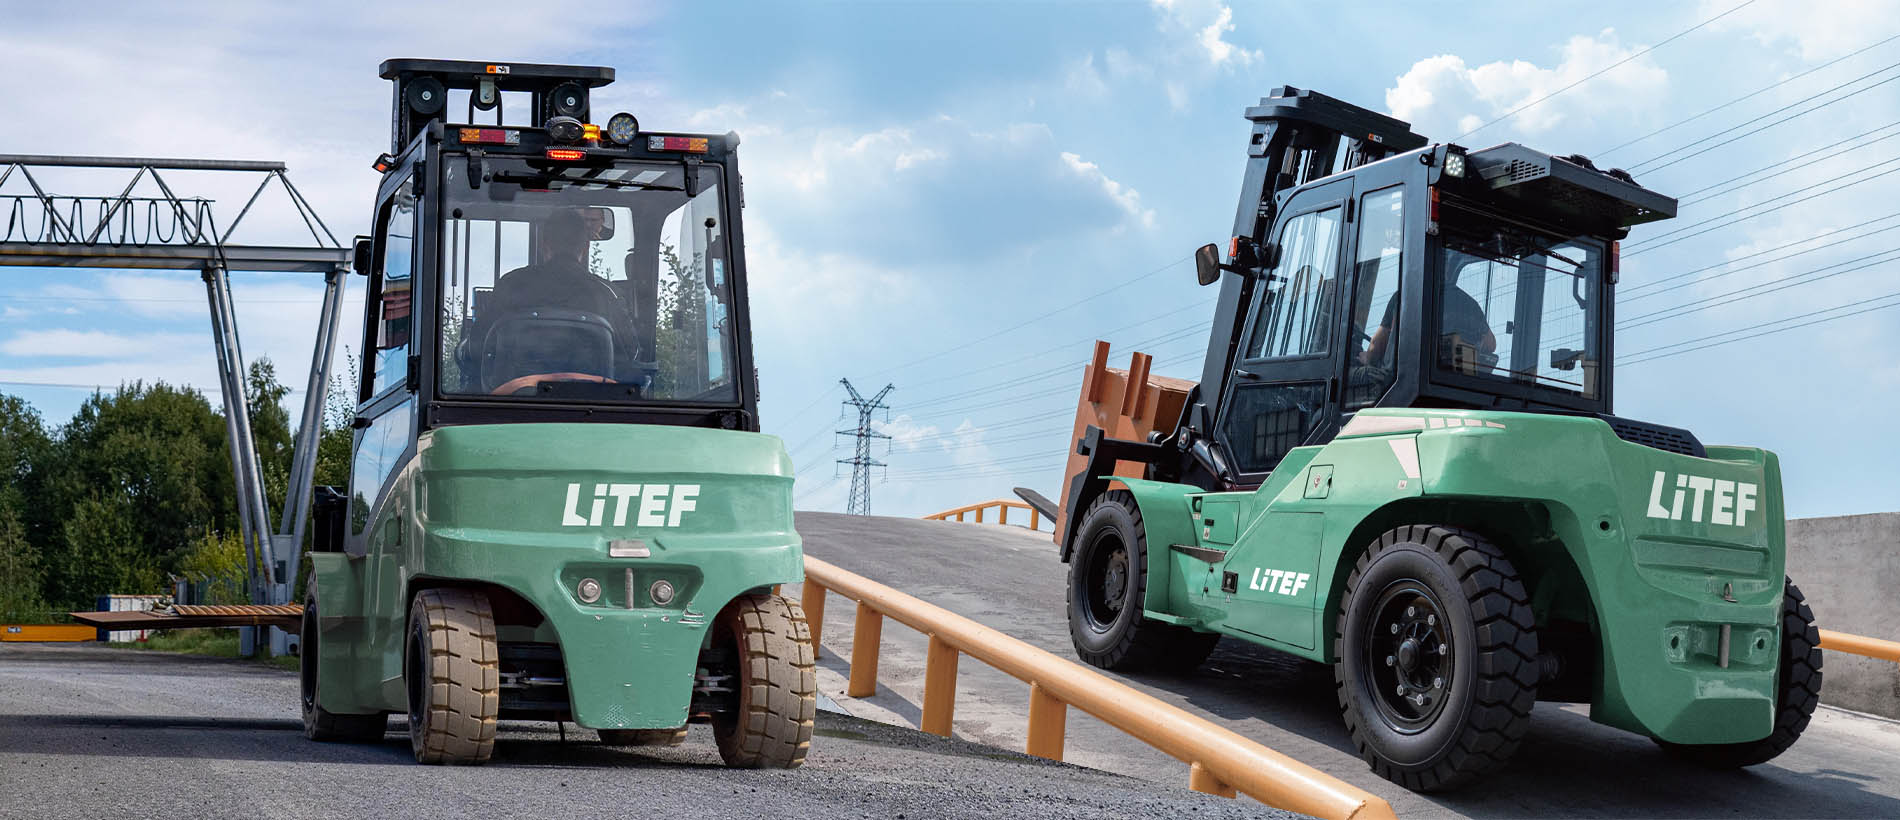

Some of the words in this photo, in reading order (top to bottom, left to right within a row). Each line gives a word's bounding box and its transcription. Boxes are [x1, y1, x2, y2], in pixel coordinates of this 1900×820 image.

[562, 483, 700, 527] LiTEF
[1646, 470, 1758, 526] LiTEF
[1249, 567, 1310, 596] LiTEF
